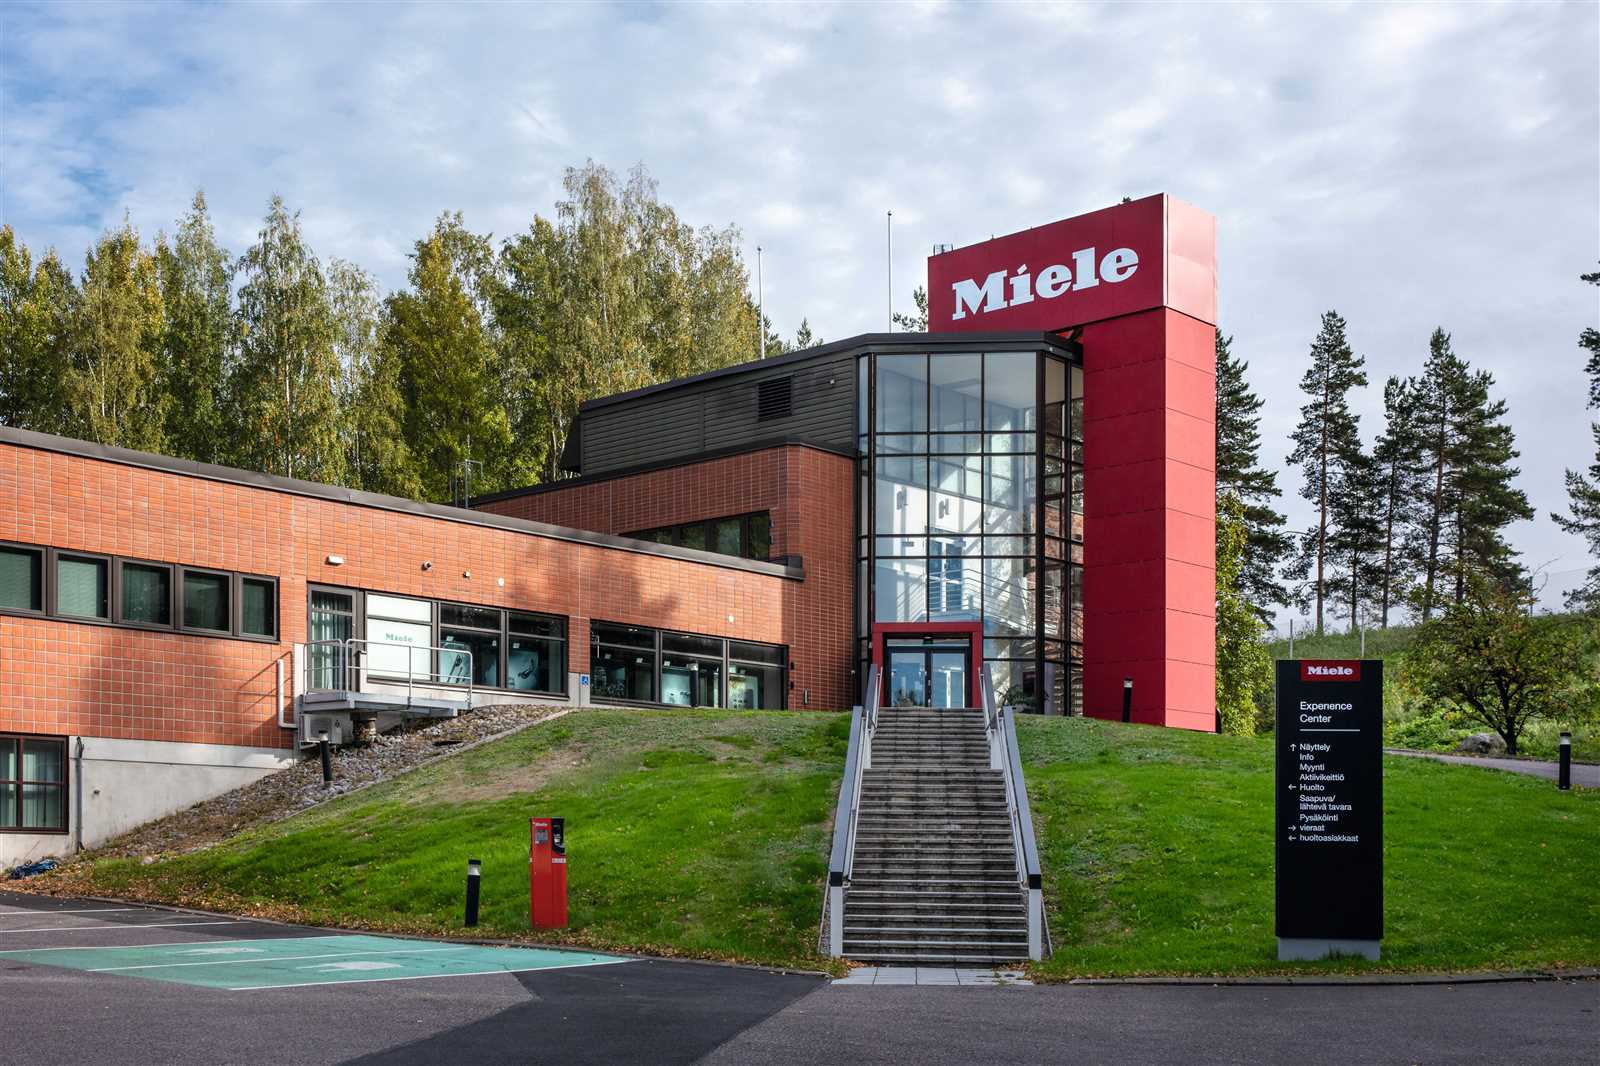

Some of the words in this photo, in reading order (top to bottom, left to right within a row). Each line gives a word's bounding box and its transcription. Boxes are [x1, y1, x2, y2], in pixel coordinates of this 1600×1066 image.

[952, 247, 1139, 321] Miele
[385, 632, 413, 642] Miele
[1307, 666, 1353, 675] Miele
[1300, 701, 1353, 712] Experience
[1300, 714, 1332, 723] Center
[1299, 743, 1331, 752] Näyttely
[1299, 753, 1314, 761] Info
[1299, 763, 1325, 772] Myynti
[1299, 783, 1325, 791] Huolto
[1299, 794, 1336, 803] Saapuva/
[1299, 803, 1327, 811] lähtevä
[1328, 803, 1352, 811] tavara
[1299, 813, 1339, 823] Pysäköinti
[1299, 824, 1325, 832] vieraat
[1299, 834, 1359, 842] huoltoasiakkaat
